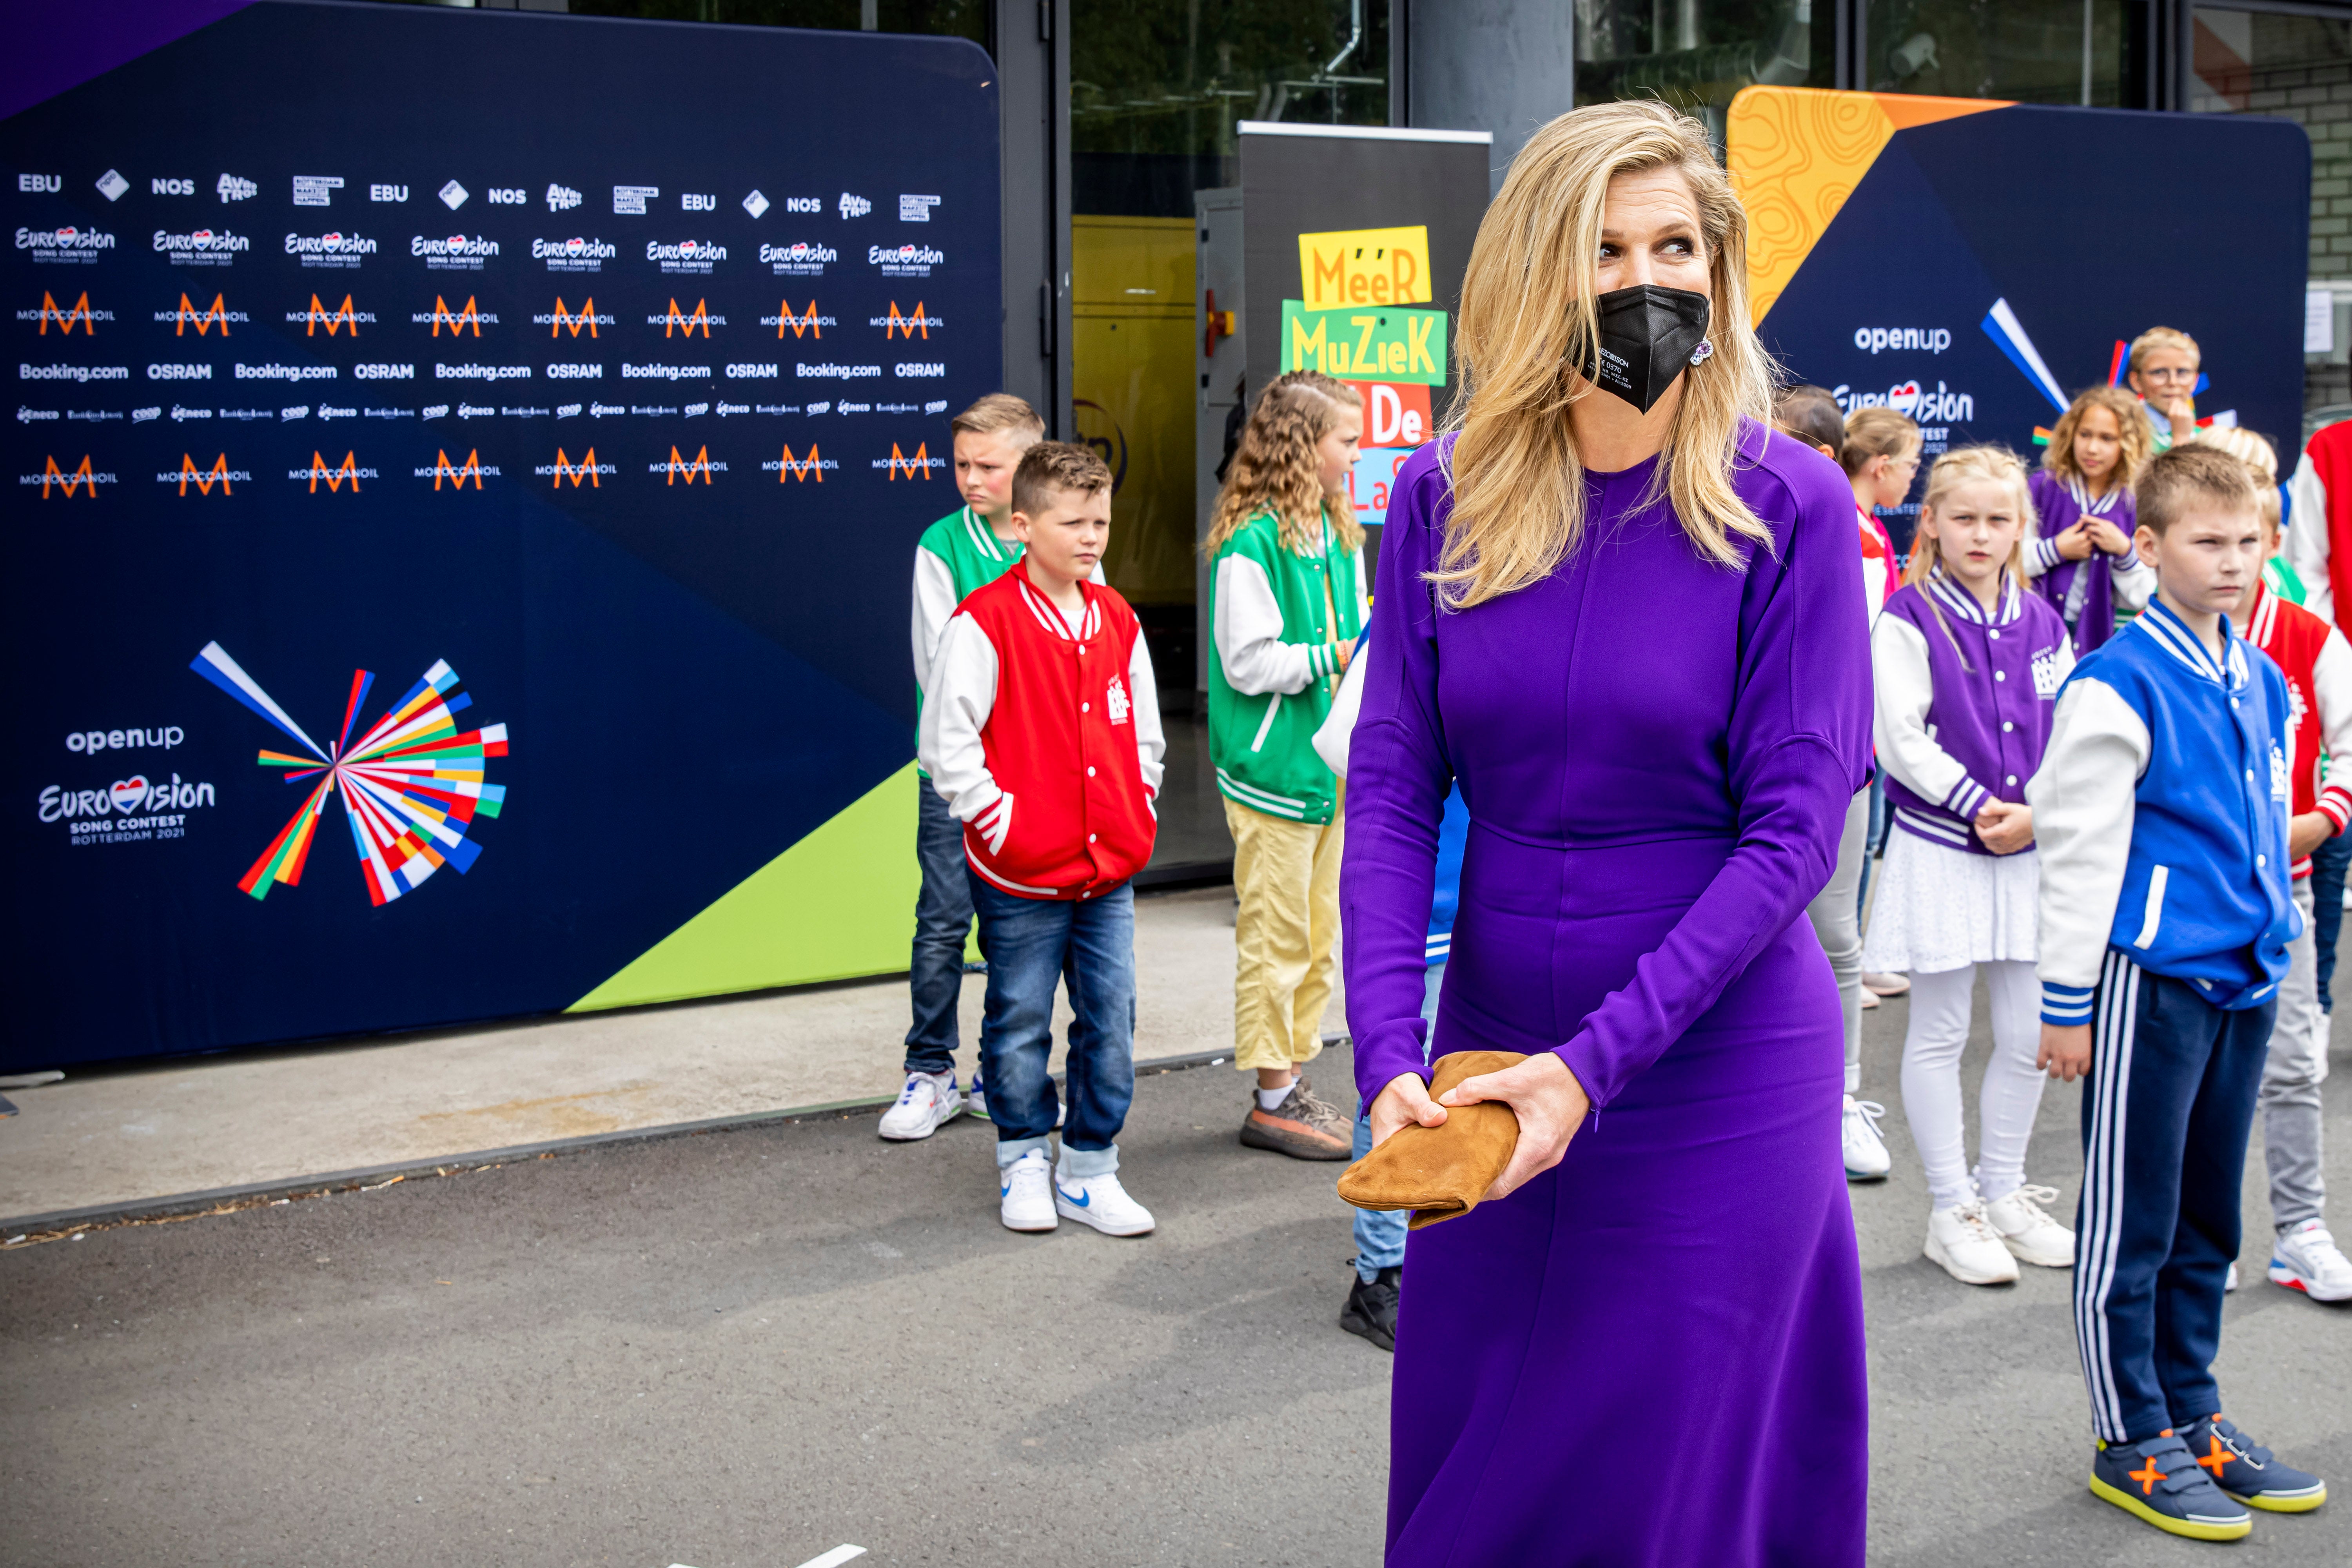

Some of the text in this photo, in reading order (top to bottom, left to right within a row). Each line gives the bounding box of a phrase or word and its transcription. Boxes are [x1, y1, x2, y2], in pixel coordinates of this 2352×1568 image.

[19, 174, 61, 192] EBU
[152, 179, 194, 195] NOS
[370, 185, 408, 202] EBU
[489, 189, 526, 204] NOS
[682, 194, 715, 211] EBU
[787, 198, 821, 212] NOS
[16, 310, 115, 321] MOROCCANOIL
[154, 311, 250, 322] MOROCCANOIL
[286, 312, 377, 323] MOROCCANOIL
[412, 313, 499, 323] MOROCCANOIL
[533, 314, 615, 325] MOROCCANOIL
[648, 315, 727, 325] MOROCCANOIL
[760, 316, 837, 326] MOROCCANOIL
[869, 317, 943, 327] MOROCCANOIL
[1292, 316, 1436, 374] MuZieK
[20, 364, 128, 382] Booking.com
[147, 364, 211, 379] OSRAM
[235, 363, 337, 381] Booking.com
[354, 364, 414, 379] OSRAM
[436, 363, 531, 381] Booking.com
[547, 364, 602, 378] OSRAM
[622, 363, 711, 380] Booking.com
[726, 364, 777, 378] OSRAM
[797, 363, 881, 379] Booking.com
[895, 363, 944, 377] OSRAM
[1606, 361, 1622, 374] 0370
[281, 405, 309, 418] coop
[325, 407, 357, 416] Eneco
[423, 405, 449, 417] coop
[465, 406, 495, 416] Eneco
[557, 403, 582, 416] coop
[596, 405, 625, 414] Eneco
[684, 403, 708, 414] coop
[722, 404, 750, 413] Eneco
[807, 401, 830, 413] coop
[843, 403, 870, 412] Eneco
[925, 400, 947, 412] coop
[25, 409, 59, 419] Eneco
[132, 407, 161, 419] coop
[178, 408, 212, 418] Eneco
[1371, 385, 1422, 443] De
[649, 462, 728, 472] MOROCCANOIL
[762, 460, 839, 470] MOROCCANOIL
[872, 457, 946, 468] MOROCCANOIL
[289, 468, 379, 479] MOROCCANOIL
[414, 466, 501, 477] MOROCCANOIL
[535, 464, 617, 475] MOROCCANOIL
[20, 473, 118, 485] MOROCCANOIL
[157, 471, 252, 482] MOROCCANOIL
[70, 814, 186, 834] SONG CONTEST
[71, 828, 185, 846] ROTTERDAM 2021
